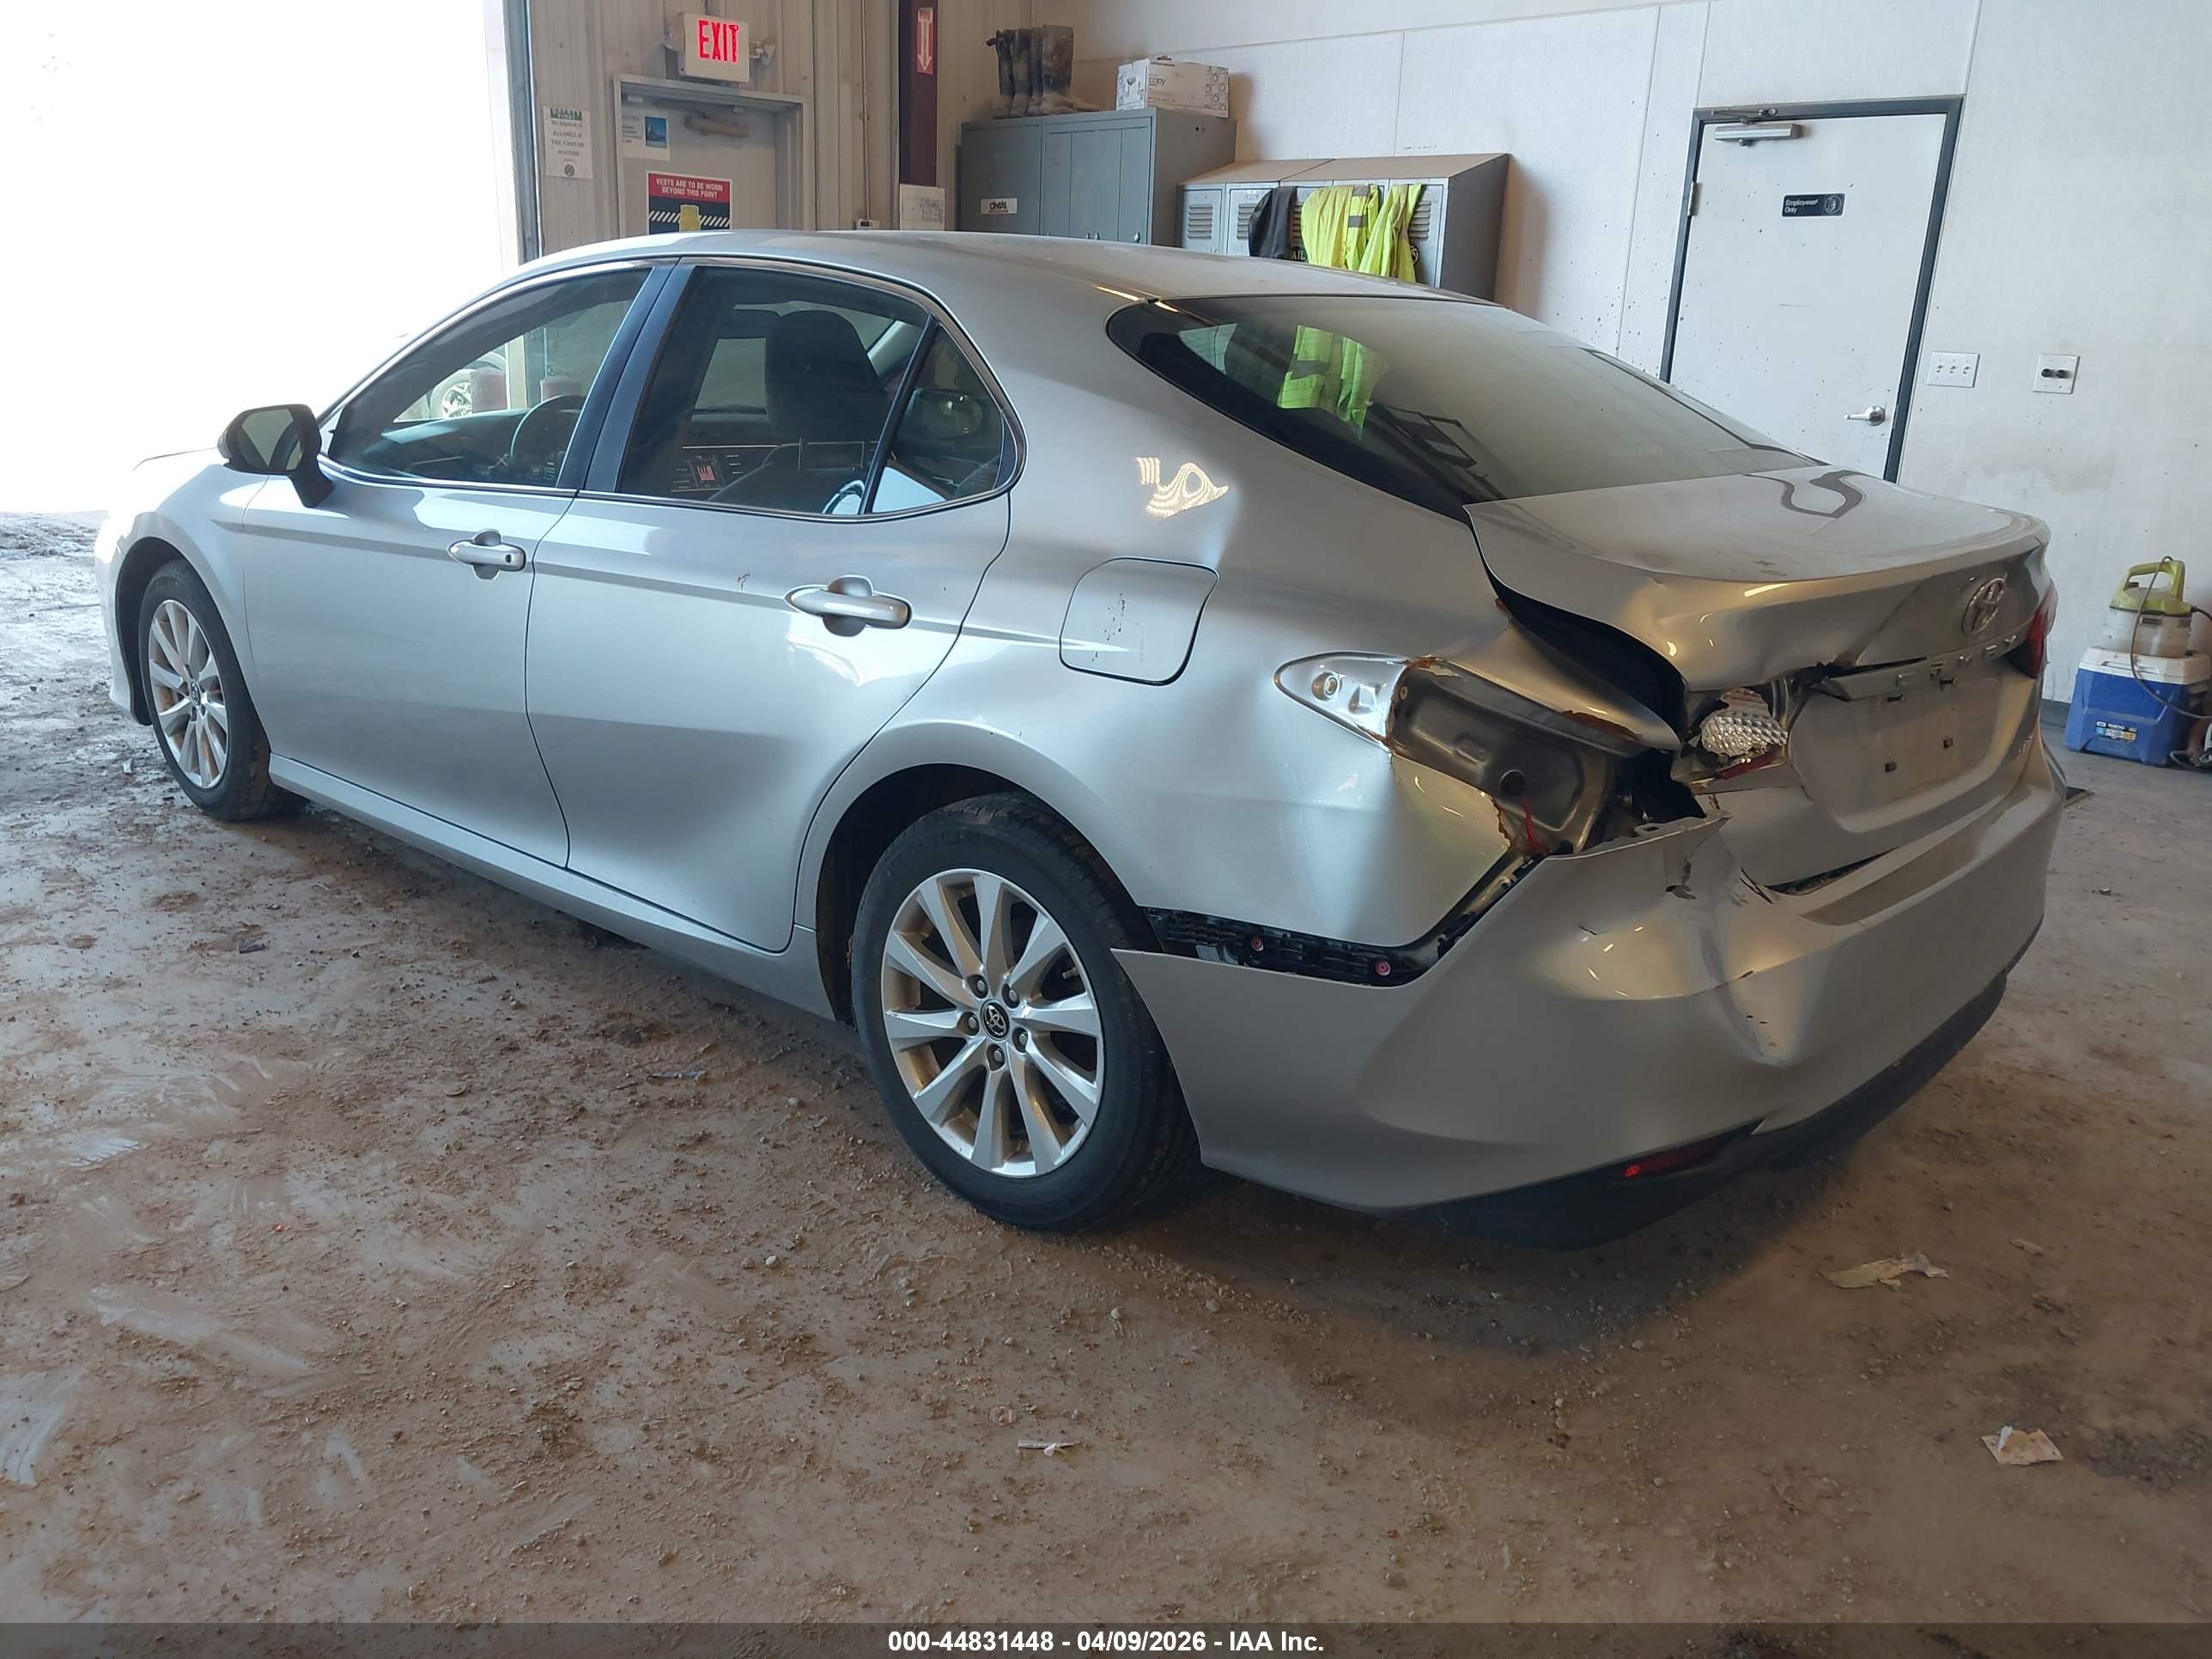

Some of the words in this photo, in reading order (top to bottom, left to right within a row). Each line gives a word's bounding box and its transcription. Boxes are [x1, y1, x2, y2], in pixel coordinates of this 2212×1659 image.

[697, 19, 739, 64] EXIT
[1149, 76, 1166, 86] copy
[655, 178, 675, 187] VESTS
[675, 179, 687, 188] ARE
[688, 180, 696, 189] TO
[705, 183, 723, 192] WORN
[661, 186, 685, 195] BEYOND
[686, 188, 700, 197] THIS
[700, 190, 718, 198] POINT
